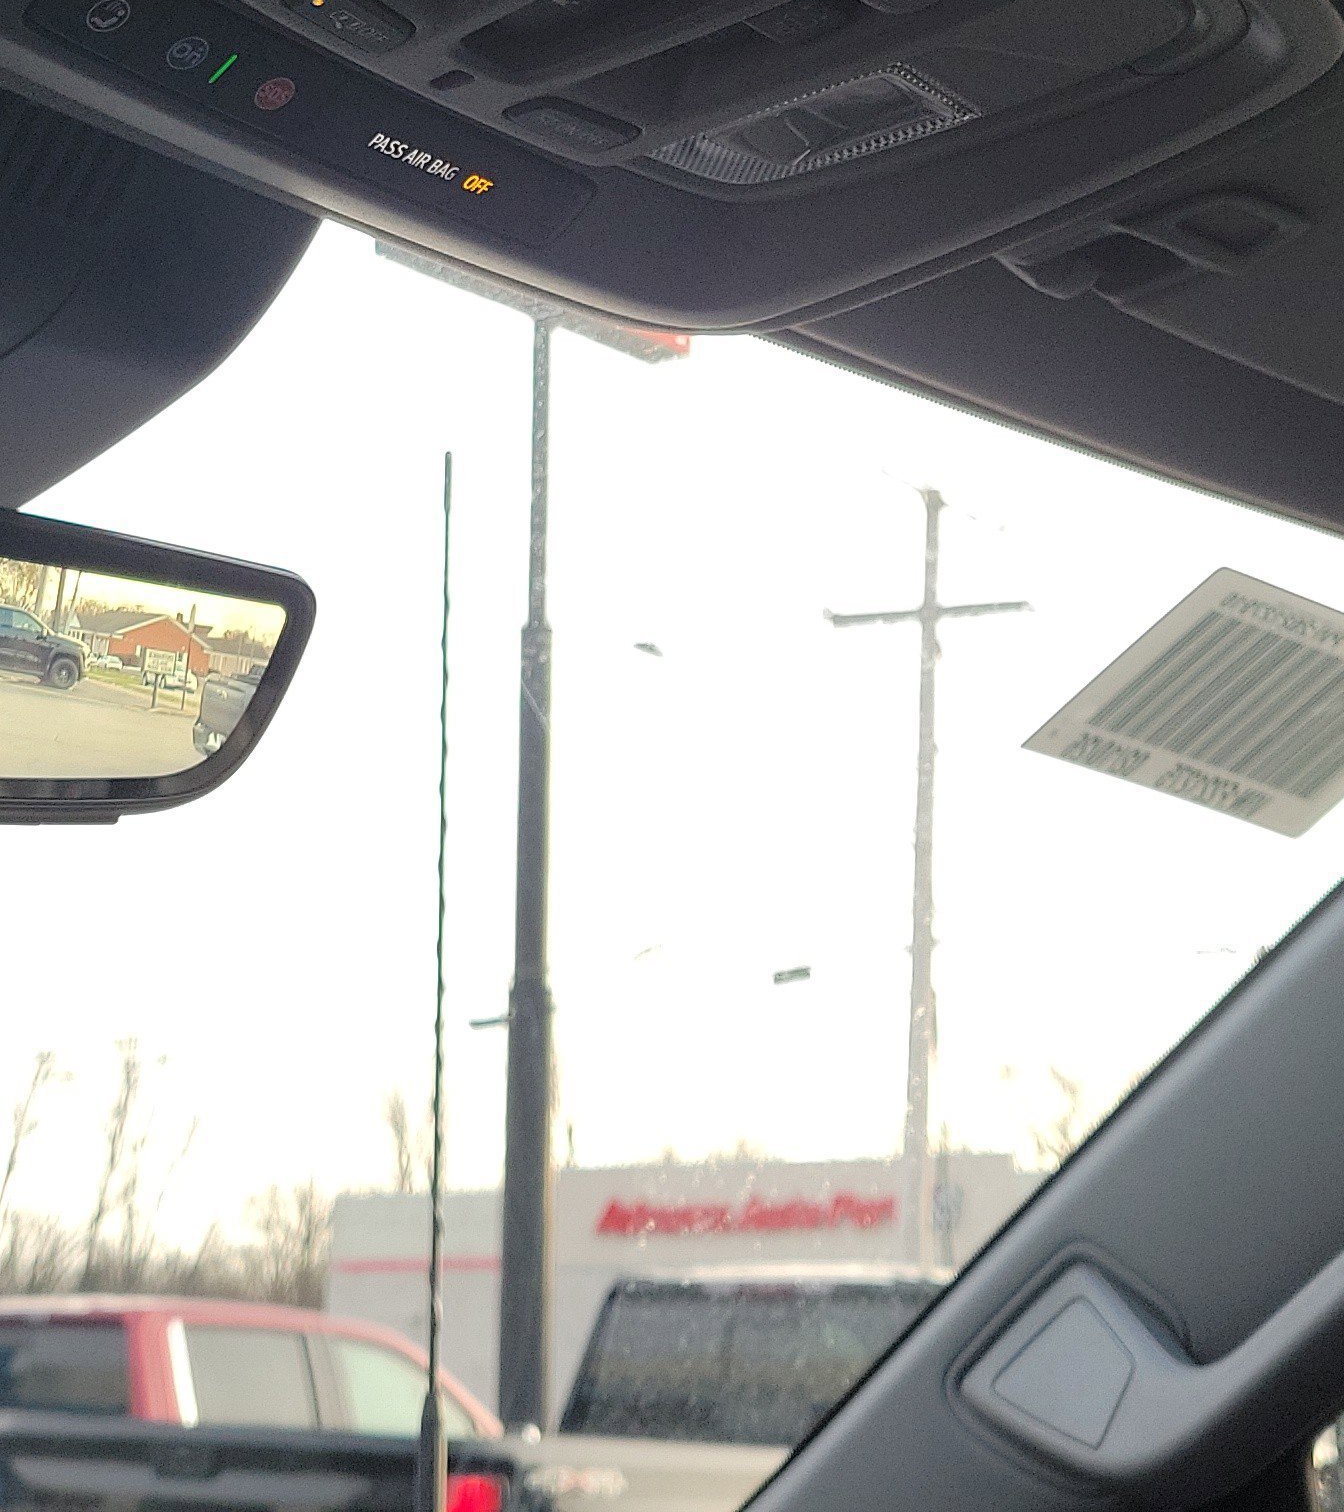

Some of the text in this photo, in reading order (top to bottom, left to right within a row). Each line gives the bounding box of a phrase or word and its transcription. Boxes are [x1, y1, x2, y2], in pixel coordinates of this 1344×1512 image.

[367, 132, 495, 196] PASS AIR BAG OFF
